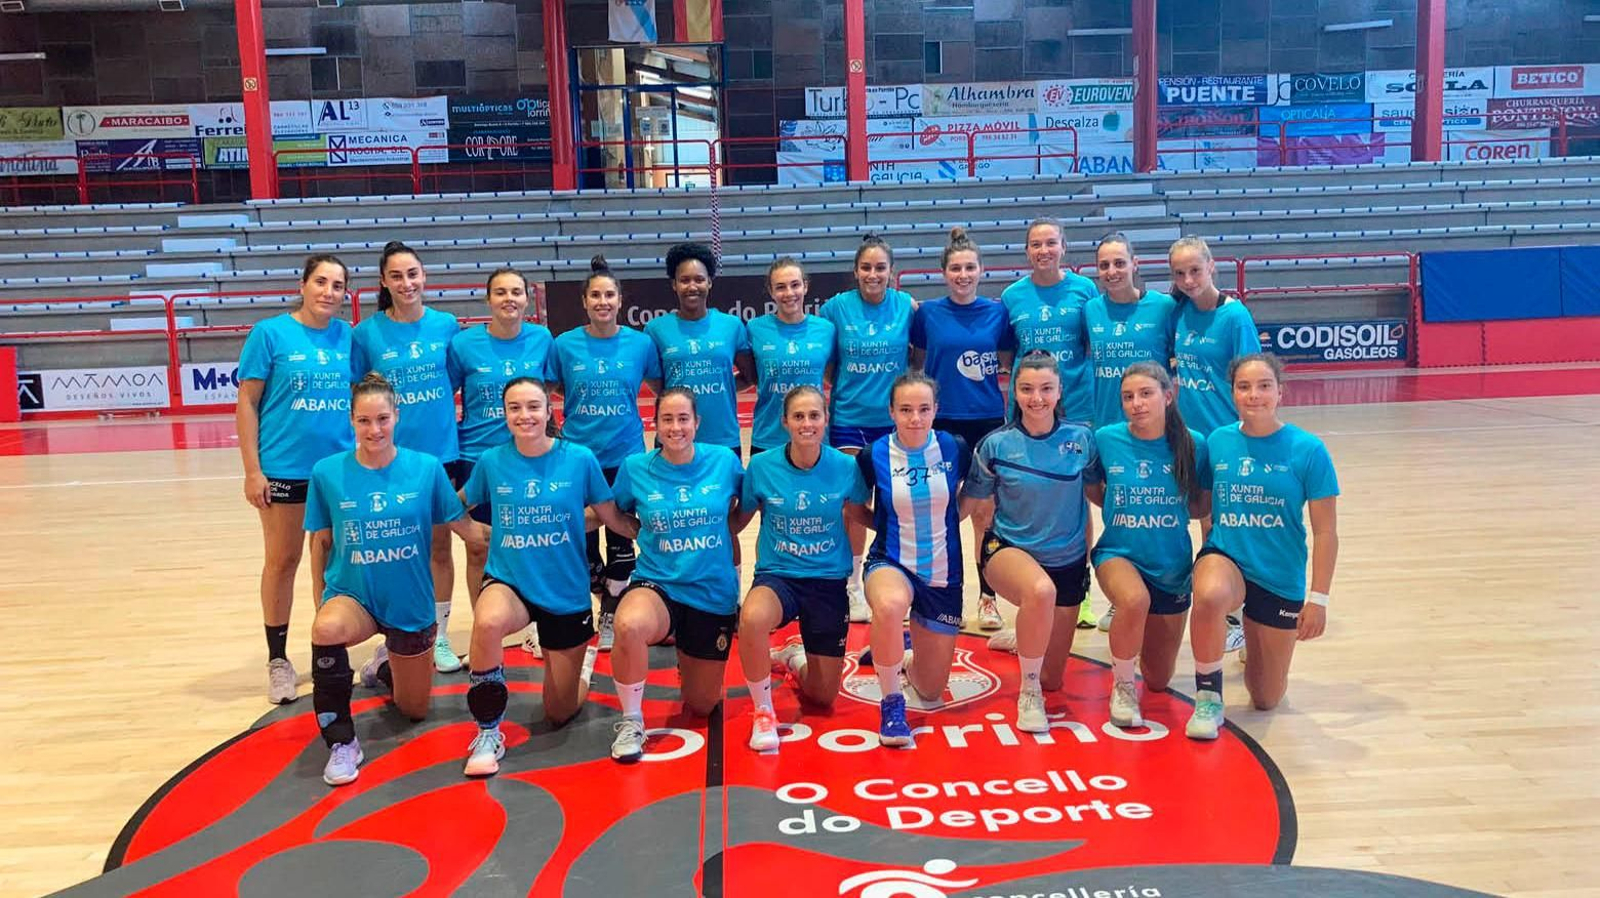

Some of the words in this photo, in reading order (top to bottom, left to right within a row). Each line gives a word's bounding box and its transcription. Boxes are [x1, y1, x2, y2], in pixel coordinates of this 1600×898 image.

[1517, 71, 1579, 84] BETICO
[1295, 77, 1361, 91] COVELO
[947, 86, 1035, 101] Alhambra
[1074, 86, 1133, 102] EUROVEN
[1166, 86, 1255, 102] PUENTE
[348, 101, 359, 110] 13
[1506, 97, 1585, 108] CHURRASQUERÍA
[111, 117, 182, 126] MARACAIBO
[948, 122, 978, 131] PIZZA
[1045, 116, 1099, 128] Descalza
[349, 134, 408, 144] MECANICA
[1277, 325, 1398, 349] CODISOIL
[1106, 342, 1134, 350] XUNTA
[1324, 347, 1398, 360] GASÓLEOS
[905, 467, 931, 487] 37
[1130, 486, 1166, 495] XUNTA
[1230, 484, 1264, 494] XUNTA
[1130, 495, 1142, 505] DE
[1230, 494, 1242, 503] DE
[518, 505, 552, 515] XUNTA
[672, 508, 708, 519] XUNTA
[365, 518, 401, 530] XUNTA
[518, 515, 530, 525] DE
[673, 519, 686, 529] DE
[789, 516, 823, 526] XUNTA
[1219, 513, 1285, 528] ABANCA
[366, 530, 379, 540] DE
[789, 526, 802, 535] DE
[775, 782, 828, 804] O
[854, 769, 1128, 801] Concello
[778, 809, 861, 835] do
[887, 798, 1154, 833] Deporte
